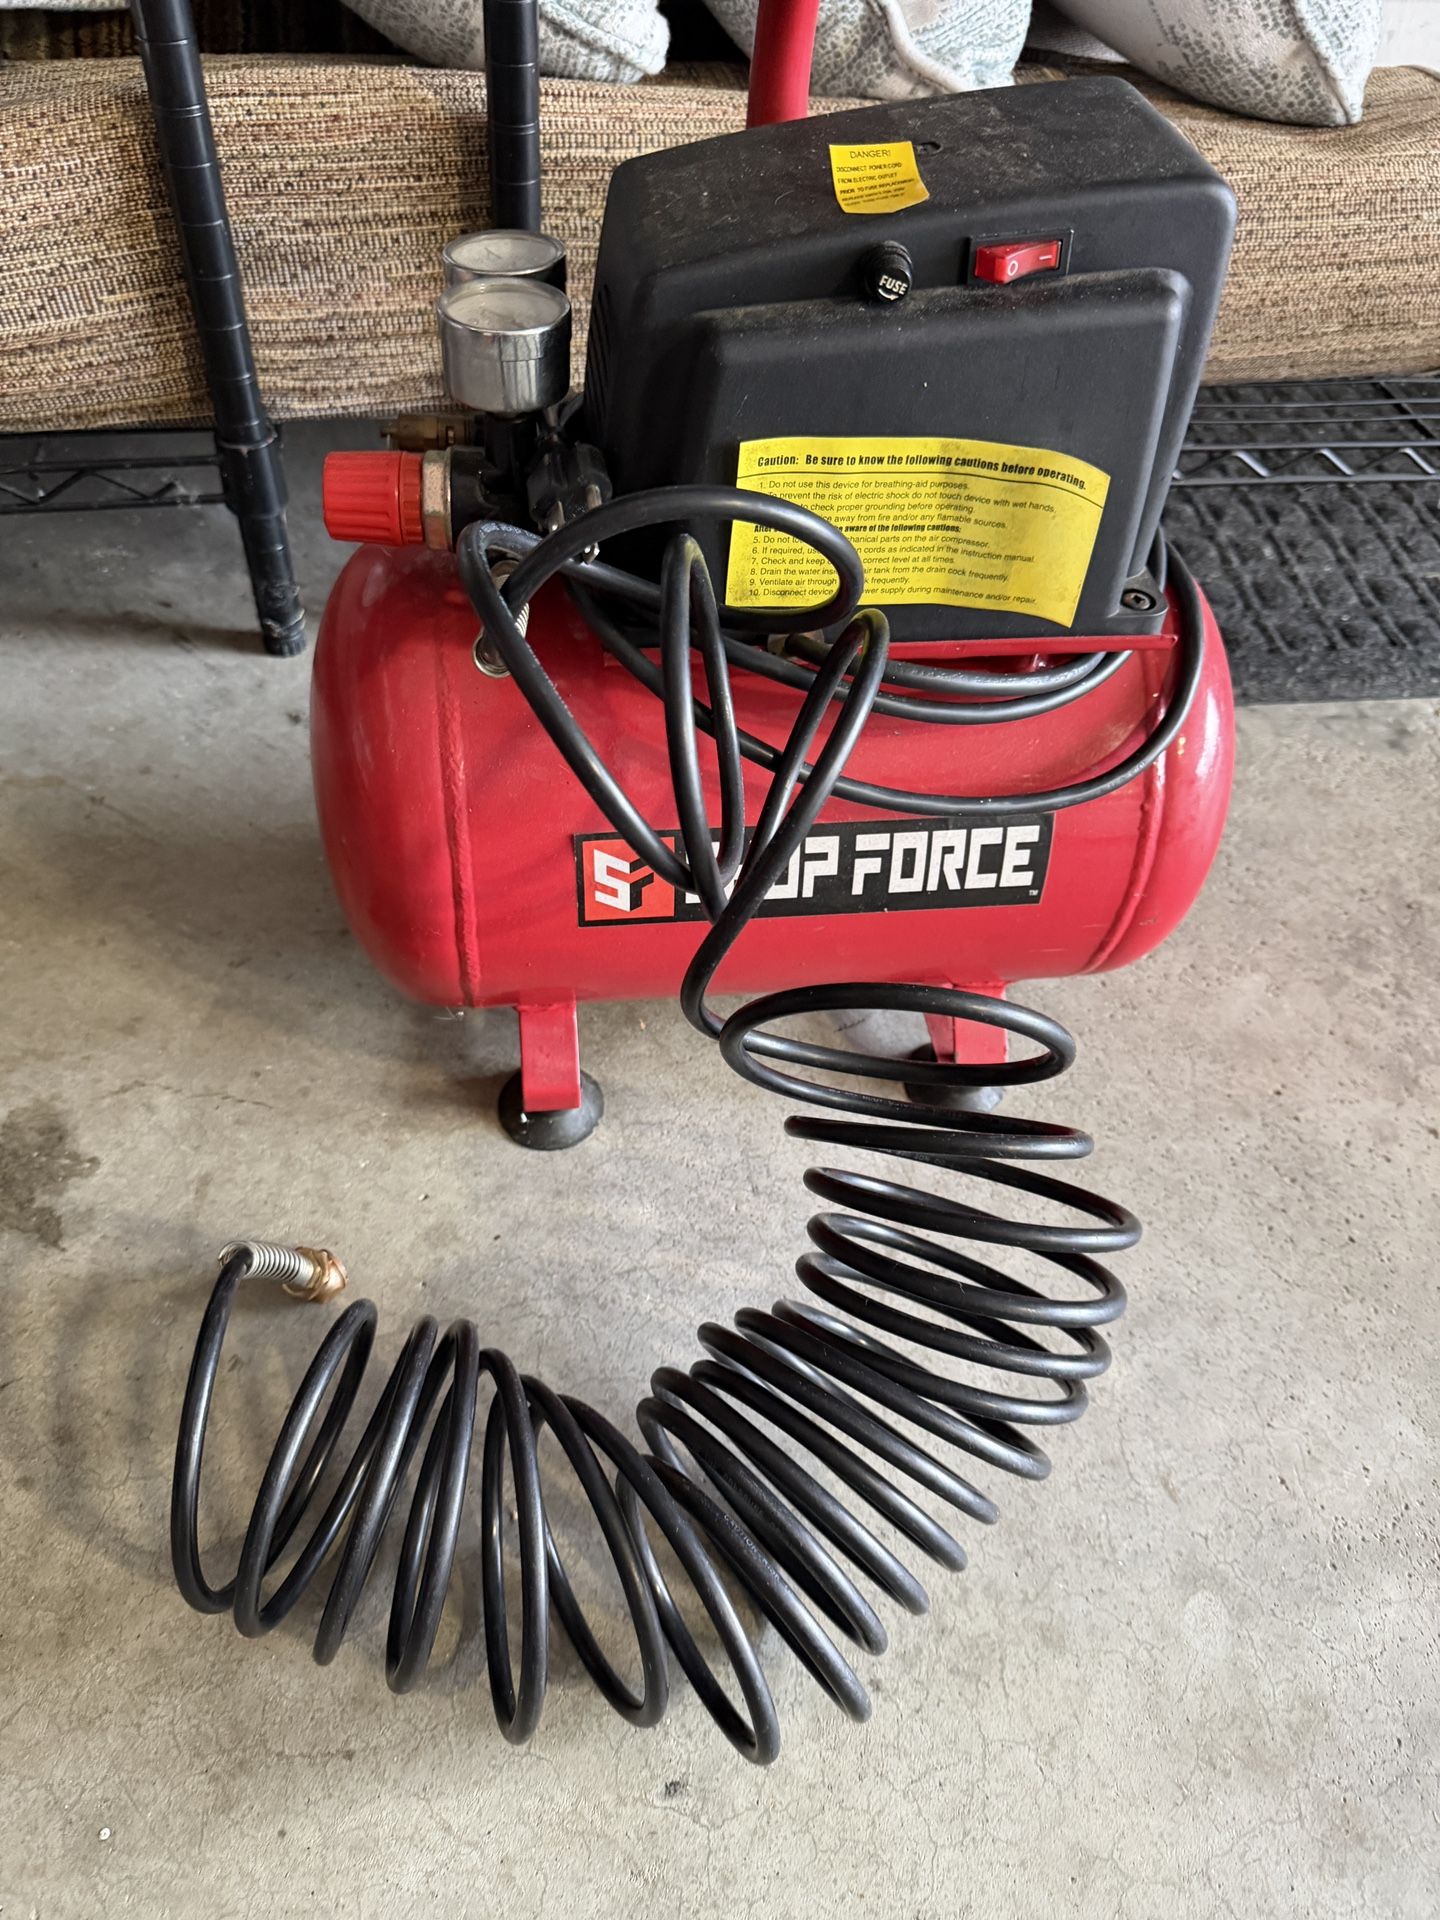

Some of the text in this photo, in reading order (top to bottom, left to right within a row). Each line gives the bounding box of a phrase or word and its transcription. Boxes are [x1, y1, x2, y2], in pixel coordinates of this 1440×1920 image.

[879, 274, 908, 295] FUSE
[758, 455, 799, 467] Caution:
[805, 454, 819, 465] Be
[820, 456, 844, 466] sure
[846, 455, 856, 466] to
[858, 454, 885, 466] know
[887, 454, 904, 466] the
[905, 454, 953, 467] following
[954, 456, 999, 471] cautions
[1001, 462, 1036, 476] before
[769, 481, 781, 489] Do
[782, 481, 796, 489] not
[815, 481, 831, 489] this
[833, 481, 860, 489] device
[861, 480, 873, 488] for
[874, 480, 928, 491] breathing-aid
[780, 492, 811, 501] prevent
[813, 492, 827, 500] the
[828, 492, 843, 500] risk
[844, 492, 854, 500] of
[854, 491, 884, 500] electric
[886, 491, 910, 500] shock
[912, 491, 922, 499] do
[924, 492, 938, 500] not
[939, 492, 962, 501] touch
[963, 494, 991, 505] device
[993, 498, 1011, 508] with
[1012, 500, 1027, 509] wet
[1028, 502, 1057, 513] hands.
[810, 503, 835, 512] check
[837, 504, 864, 513] proper
[865, 502, 906, 512] grounding
[907, 502, 933, 511] before
[834, 515, 856, 524] away
[857, 514, 876, 522] from
[878, 513, 891, 522] fire
[892, 513, 919, 522] and/or
[920, 514, 935, 523] any
[844, 525, 867, 533] aware
[869, 524, 877, 533] of
[878, 524, 891, 533] the
[891, 523, 925, 533] following
[753, 536, 761, 544] 5.
[763, 536, 775, 544] Do
[777, 536, 791, 544] not
[880, 535, 900, 544] parts
[929, 535, 939, 543] air
[941, 536, 990, 549] compressor.
[752, 546, 760, 554] 6.
[762, 546, 768, 554] If
[769, 546, 805, 556] required,
[863, 546, 886, 554] cords
[899, 545, 935, 553] indicated
[936, 545, 945, 553] in
[946, 546, 959, 554] the
[960, 548, 1002, 561] instruction
[751, 557, 759, 565] 7.
[761, 557, 787, 565] Check
[789, 557, 804, 565] and
[806, 557, 826, 567] keep
[863, 556, 890, 564] correct
[892, 555, 910, 564] level
[923, 555, 932, 563] all
[760, 567, 782, 575] Drain
[874, 566, 890, 574] tank
[892, 566, 911, 574] from
[926, 566, 946, 574] drain
[947, 568, 966, 576] cock
[749, 578, 757, 586] 9.
[759, 578, 793, 586] Ventilate
[795, 578, 806, 586] air
[807, 578, 837, 588] through
[763, 588, 807, 596] Disconnect
[808, 588, 834, 596] device
[881, 587, 905, 596] supply
[907, 586, 932, 595] during
[933, 587, 984, 599] maintenance
[985, 593, 1011, 601] and/or
[685, 825, 1040, 904] OP FORCE
